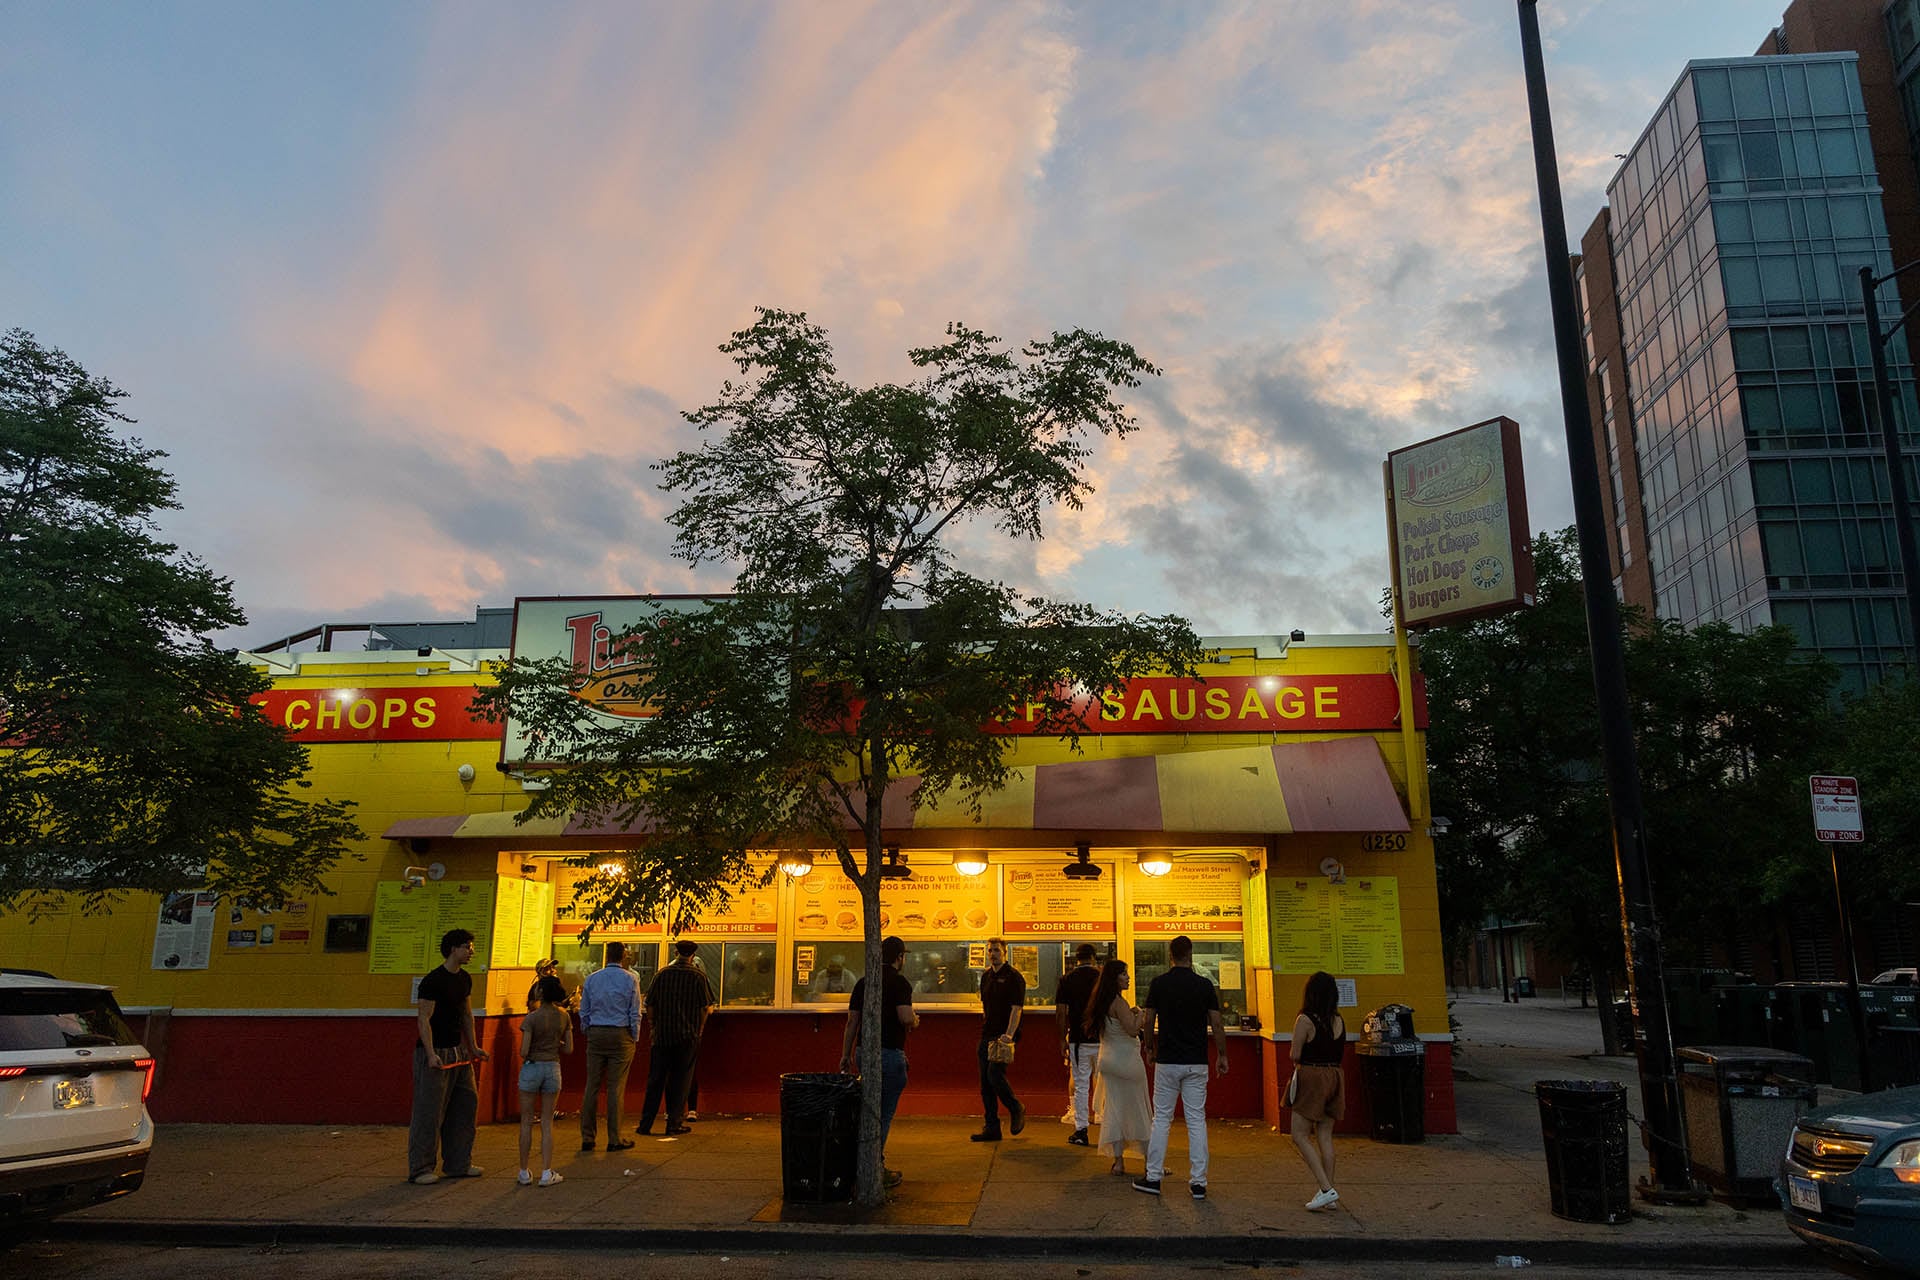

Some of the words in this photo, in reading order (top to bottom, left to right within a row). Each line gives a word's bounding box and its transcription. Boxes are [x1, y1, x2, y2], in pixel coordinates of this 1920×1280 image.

[1403, 514, 1440, 541] Polish
[1443, 503, 1504, 531] Sausage
[1404, 538, 1435, 565] Pork
[1438, 531, 1480, 556] Chops
[1406, 565, 1429, 587] Hot
[1432, 559, 1466, 582] Dogs
[1408, 588, 1461, 610] Burgers
[1101, 686, 1341, 721] SAUSAGE
[285, 697, 437, 730] CHOPS
[1367, 834, 1406, 850] 1250
[1819, 831, 1836, 839] TOW
[1839, 831, 1860, 840] ZONE
[829, 883, 857, 891] OTHER
[605, 925, 630, 933] HERE
[697, 924, 730, 933] ORDER
[731, 924, 756, 932] HERE
[1032, 923, 1065, 931] ORDER
[1068, 923, 1093, 931] HERE
[1164, 922, 1182, 930] PAY
[1185, 922, 1211, 930] HERE
